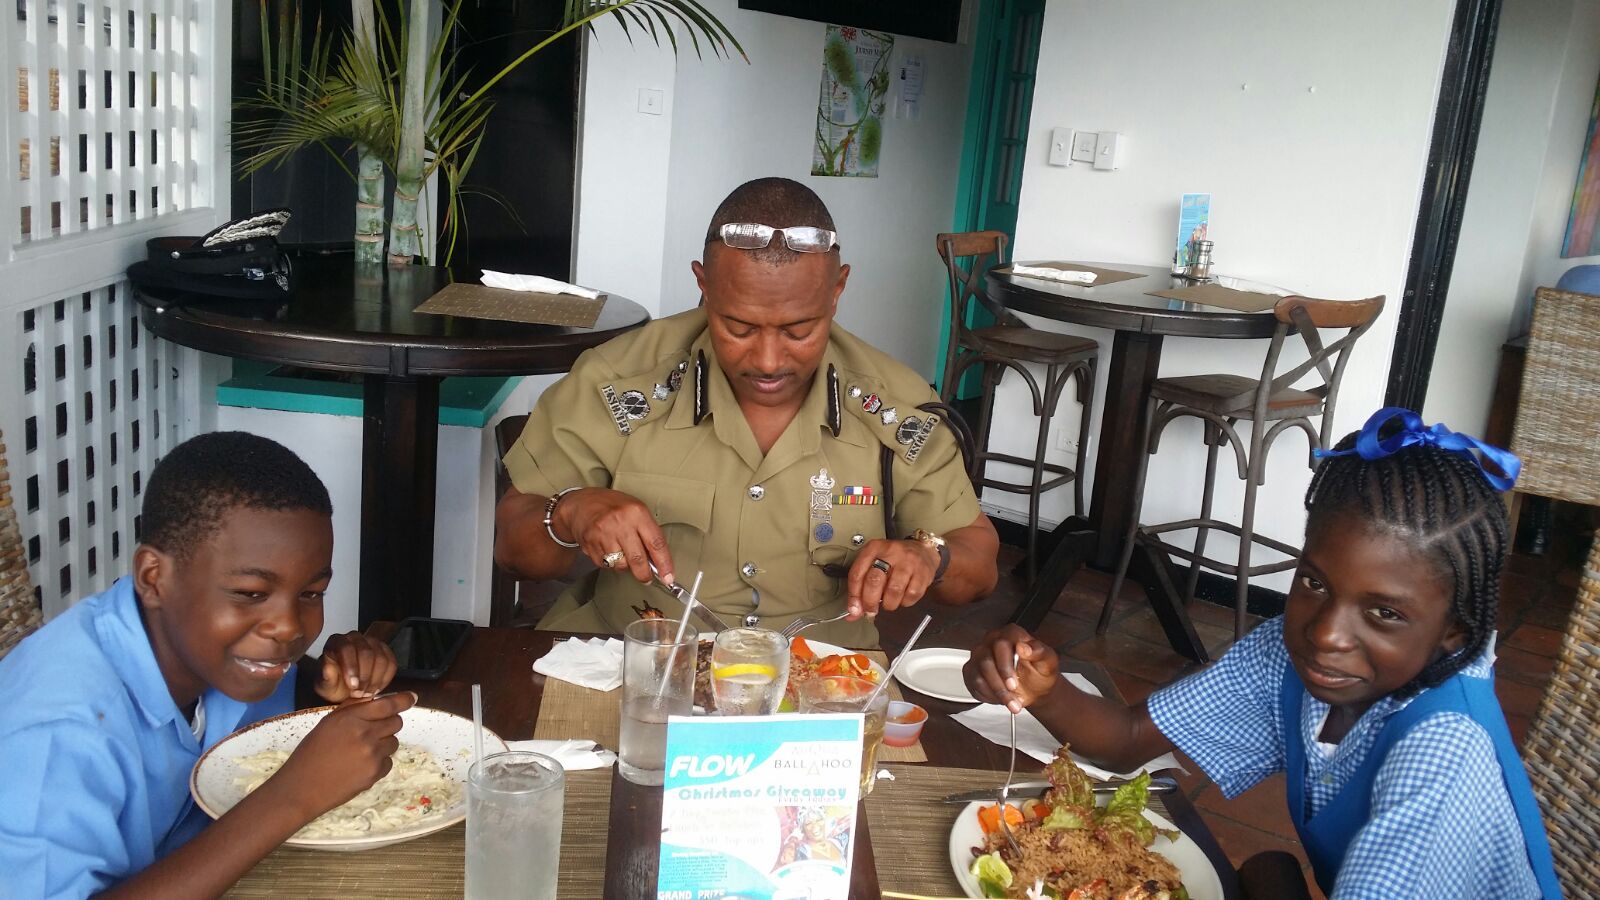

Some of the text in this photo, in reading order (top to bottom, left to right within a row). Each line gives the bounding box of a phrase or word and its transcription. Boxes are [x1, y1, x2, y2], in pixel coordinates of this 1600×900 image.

[669, 753, 755, 778] FLOW
[678, 785, 847, 800] Christmas Giveaway
[657, 890, 692, 900] GRAND
